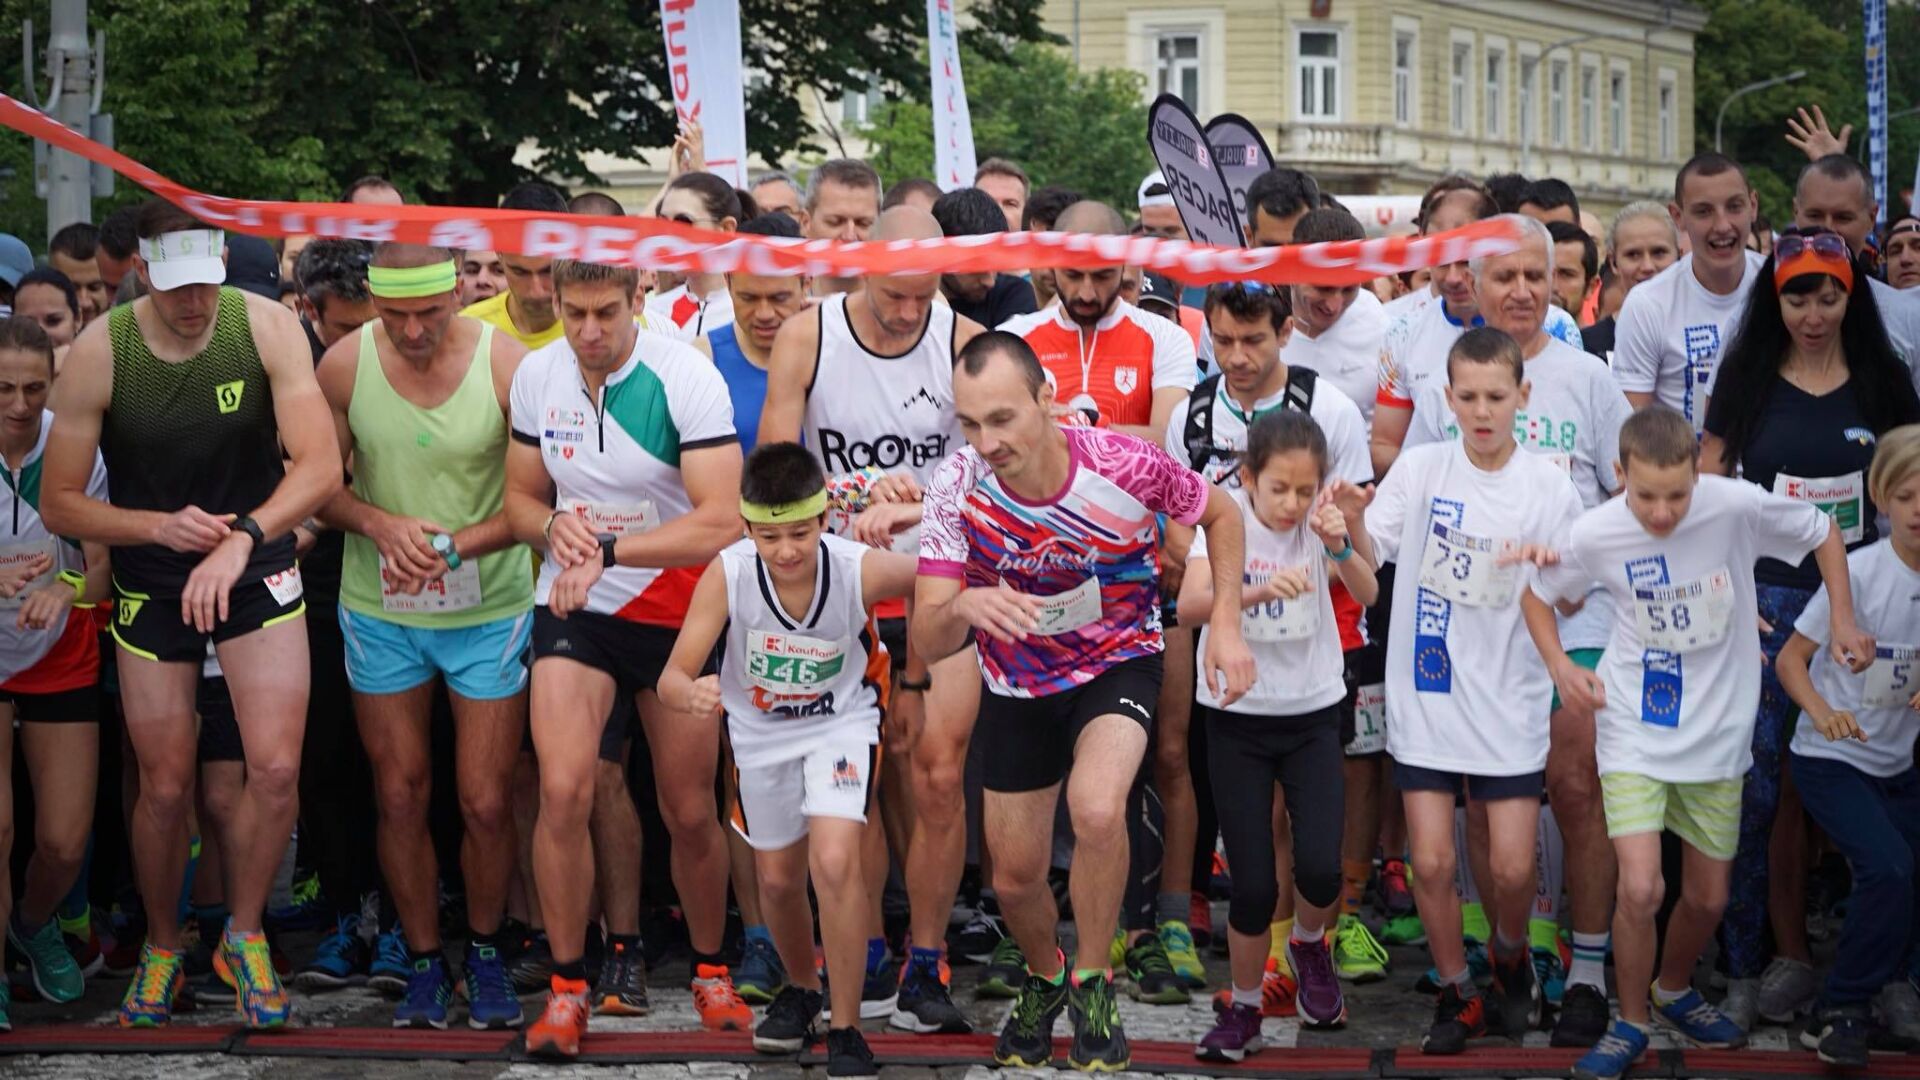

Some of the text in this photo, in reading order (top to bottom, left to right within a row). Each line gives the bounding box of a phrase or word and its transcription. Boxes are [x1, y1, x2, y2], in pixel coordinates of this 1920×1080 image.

[1807, 486, 1853, 499] Kaufland
[1432, 541, 1472, 581] 73
[1648, 603, 1691, 632] 58
[787, 645, 840, 660] Kaufland
[750, 651, 818, 684] 946
